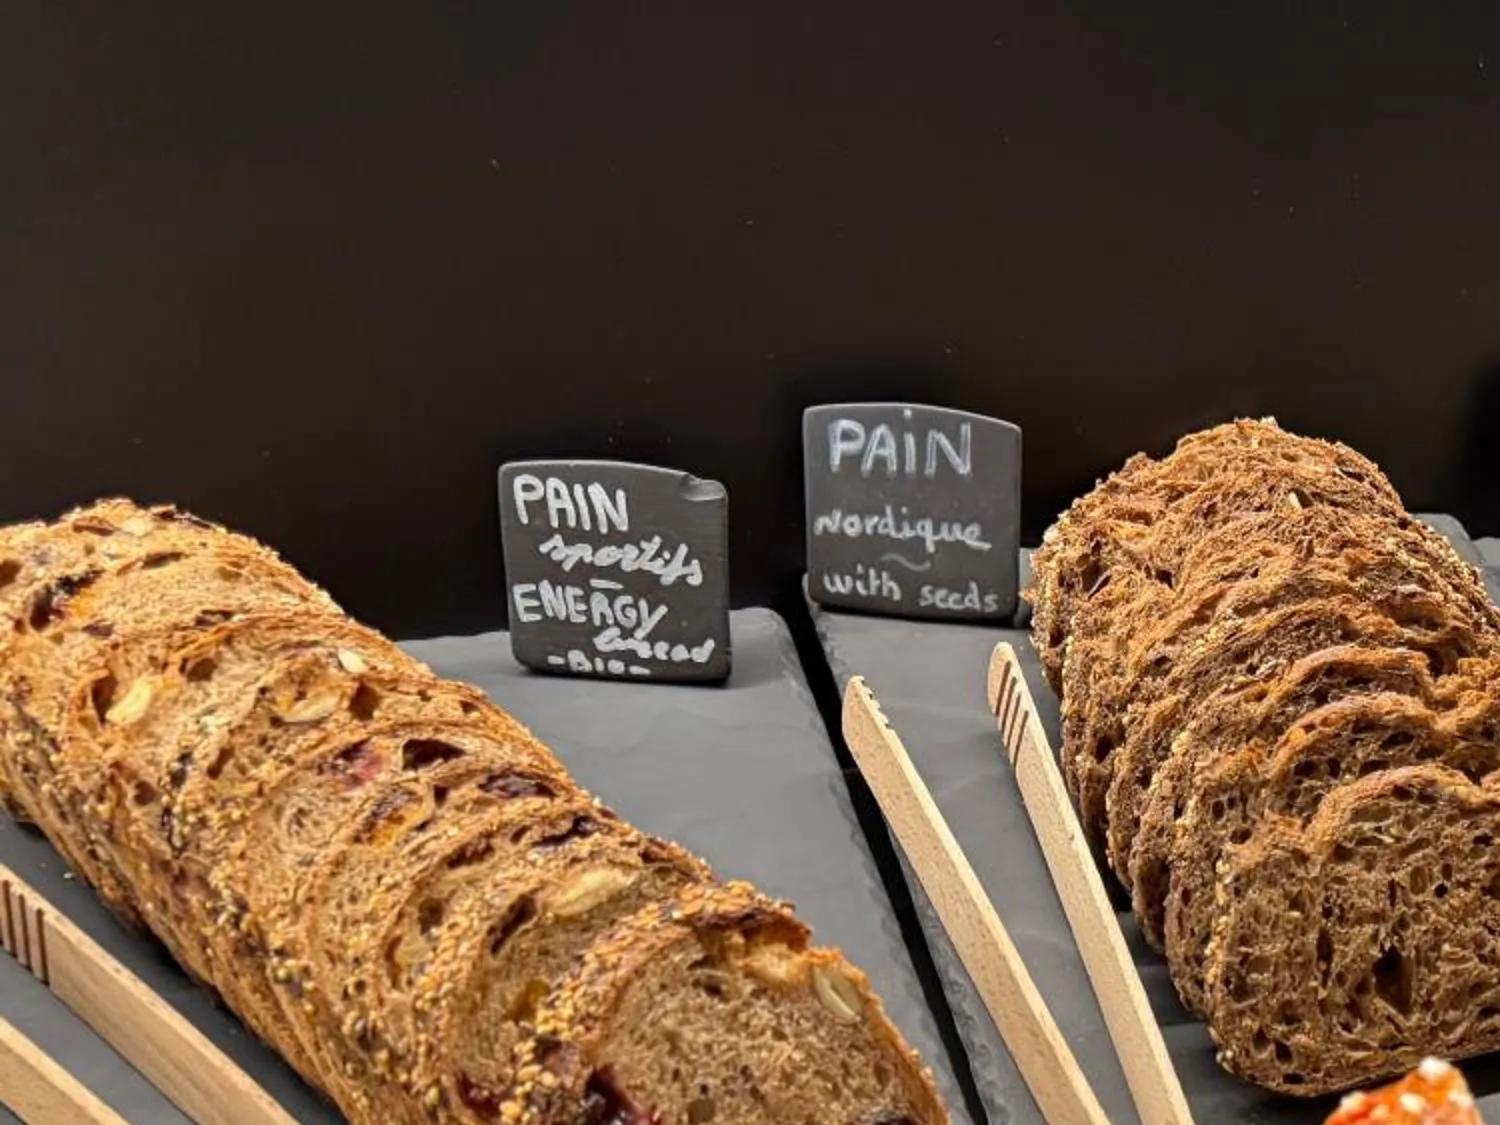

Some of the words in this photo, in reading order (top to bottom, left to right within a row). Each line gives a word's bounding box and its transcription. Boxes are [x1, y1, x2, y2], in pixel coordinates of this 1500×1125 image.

[513, 474, 629, 534] PAIN
[513, 579, 669, 640] ENERGY
[823, 563, 901, 601] with
[918, 580, 999, 613] seeds
